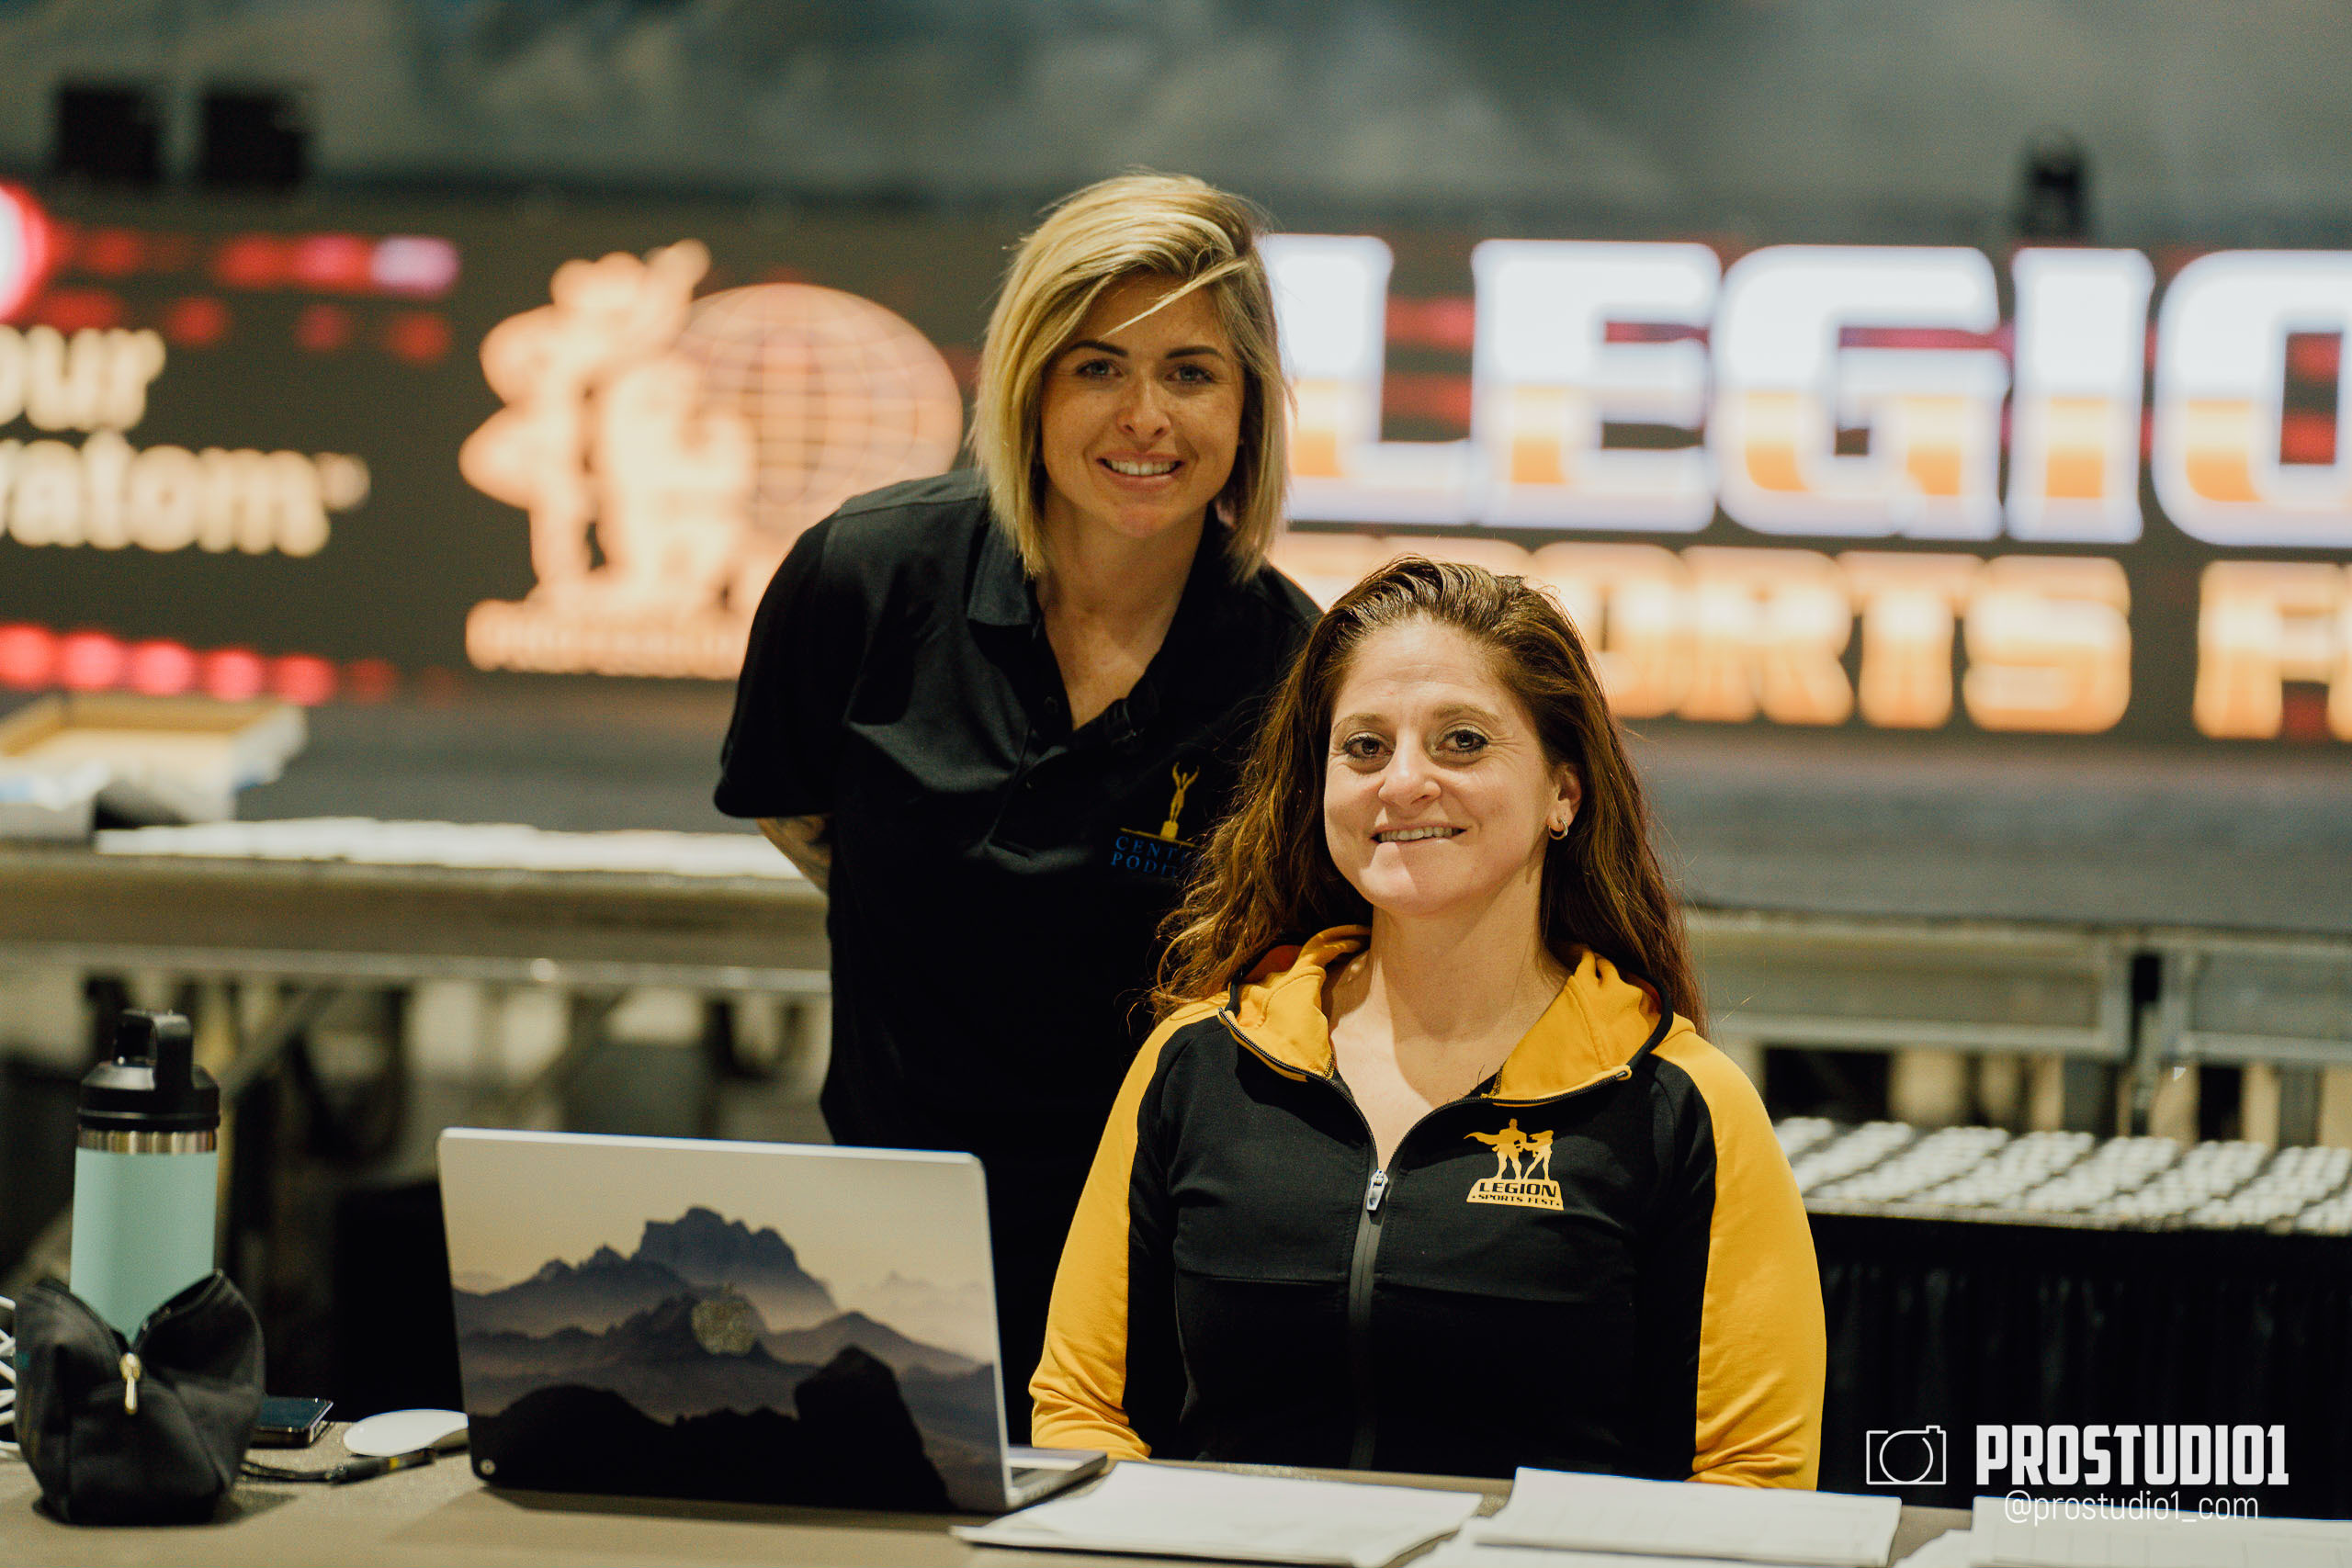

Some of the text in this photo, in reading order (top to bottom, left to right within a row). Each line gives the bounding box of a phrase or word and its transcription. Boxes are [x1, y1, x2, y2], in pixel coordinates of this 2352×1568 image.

[1268, 531, 2132, 736] ORTS
[1479, 1181, 1557, 1198] LEGION
[1478, 1194, 1554, 1206] SPORTS FEST
